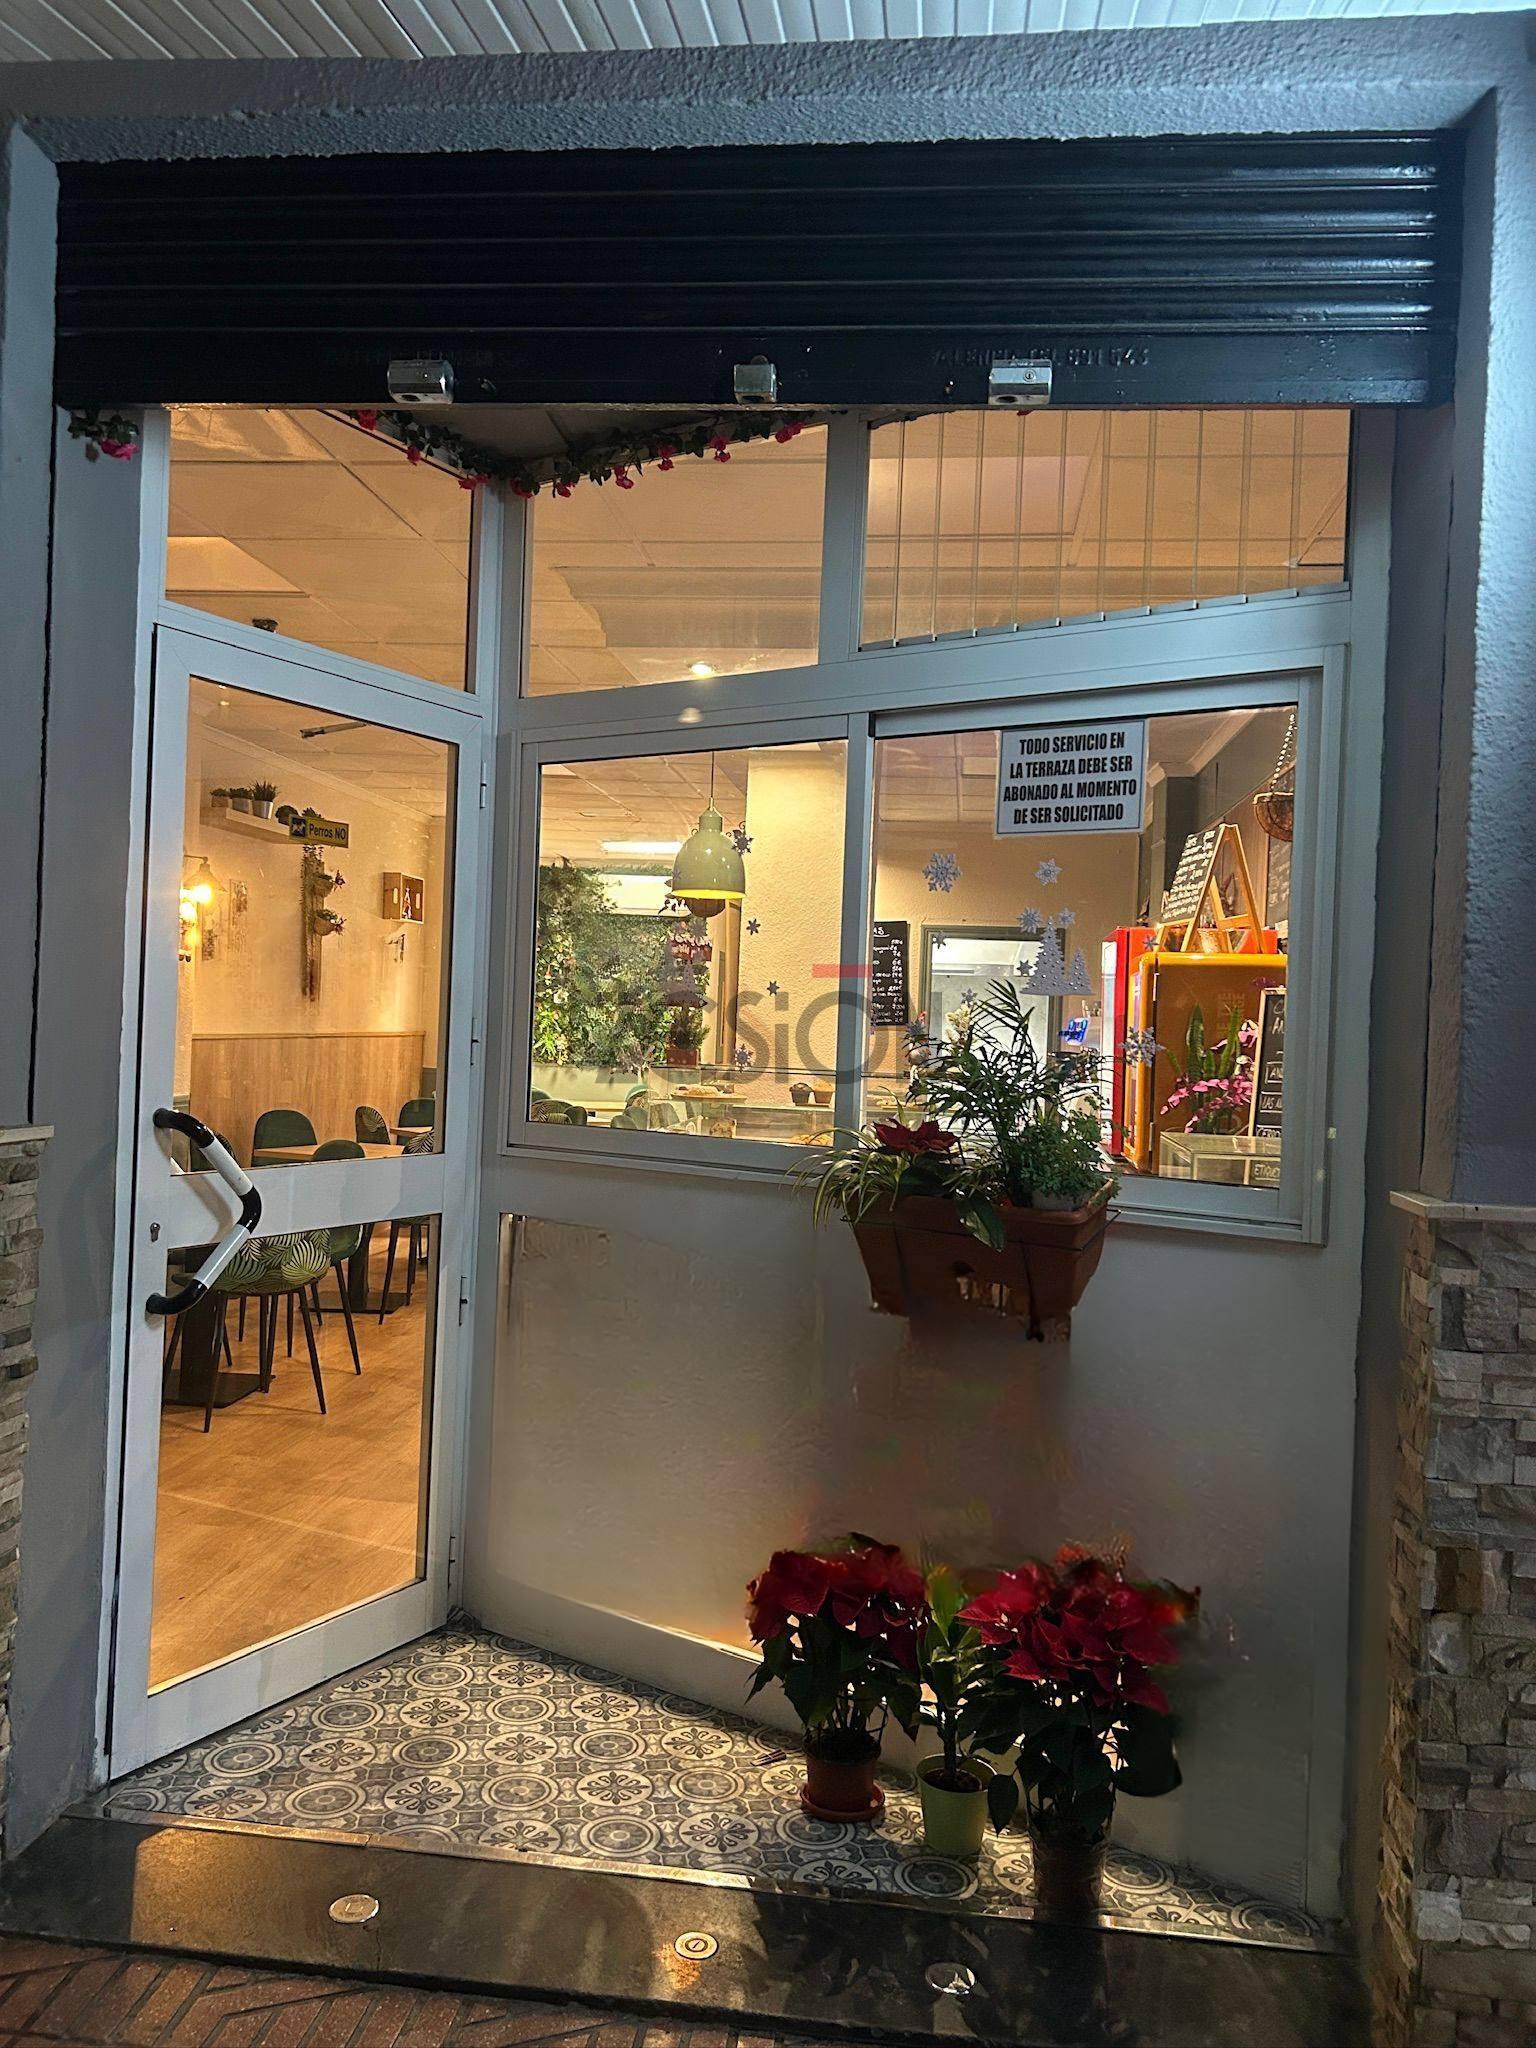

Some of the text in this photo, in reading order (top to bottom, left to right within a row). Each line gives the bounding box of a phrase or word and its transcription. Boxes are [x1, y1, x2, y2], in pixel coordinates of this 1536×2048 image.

[1020, 731, 1125, 755] TODO SERVICIO EN
[1010, 755, 1133, 779] LA TERRAZA DEBE SER
[1003, 779, 1137, 802] ABONADO AL MOMENTO
[1014, 803, 1124, 824] DE SER SOLICITADO
[308, 823, 346, 840] Perros NO
